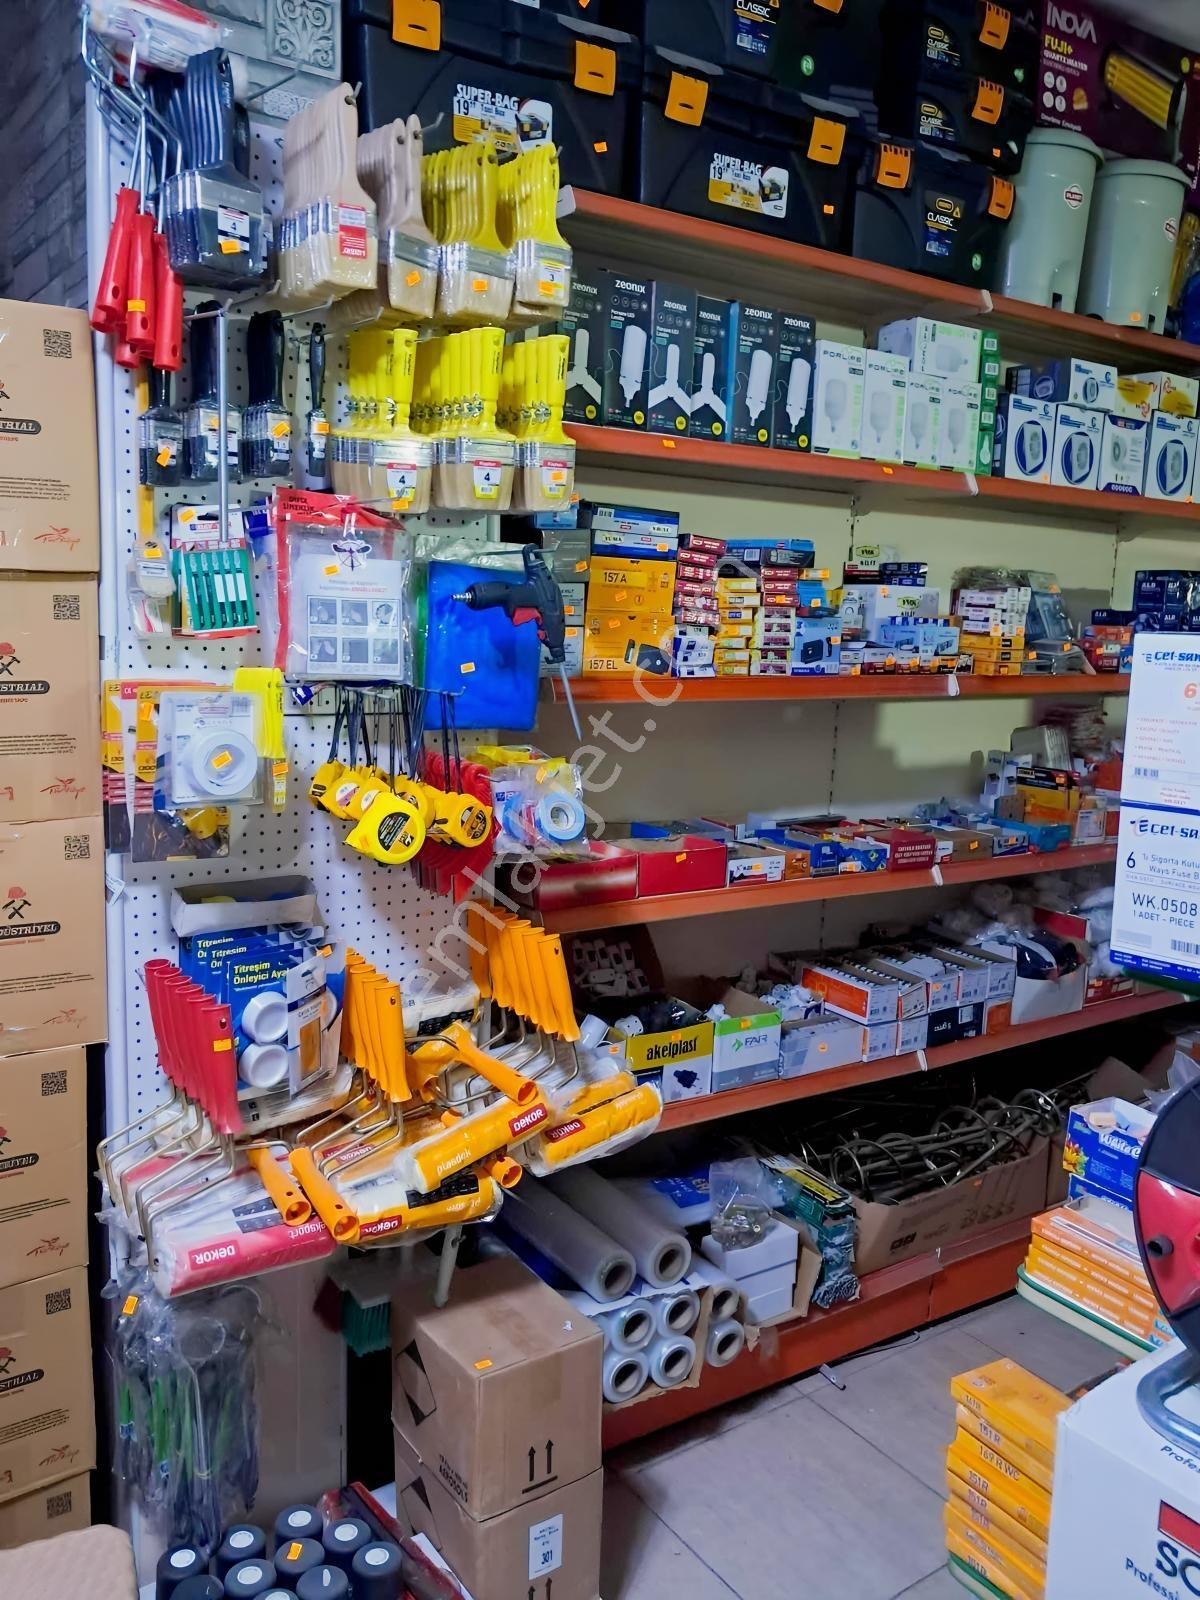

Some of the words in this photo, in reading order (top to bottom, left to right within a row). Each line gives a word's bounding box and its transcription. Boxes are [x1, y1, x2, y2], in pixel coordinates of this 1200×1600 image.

[1046, 0, 1097, 44] INOVA
[456, 83, 519, 111] SUPER-BAG
[713, 152, 763, 176] SUPER-BAG
[927, 211, 954, 227] CLASSIC
[571, 281, 598, 296] zeonix
[615, 278, 646, 294] zeonix
[744, 307, 773, 320] zeonix
[784, 317, 811, 330] zeonix
[485, 472, 491, 482] 4
[603, 572, 619, 583] 157
[620, 573, 627, 583] A
[589, 659, 604, 670] 157
[606, 659, 618, 670] EL
[1126, 851, 1136, 869] 6
[1138, 911, 1161, 922] ADET
[1169, 917, 1195, 929] PIECE
[233, 961, 270, 974] Titreşim
[233, 970, 269, 986] Önleyici
[646, 1036, 698, 1061] akelplast
